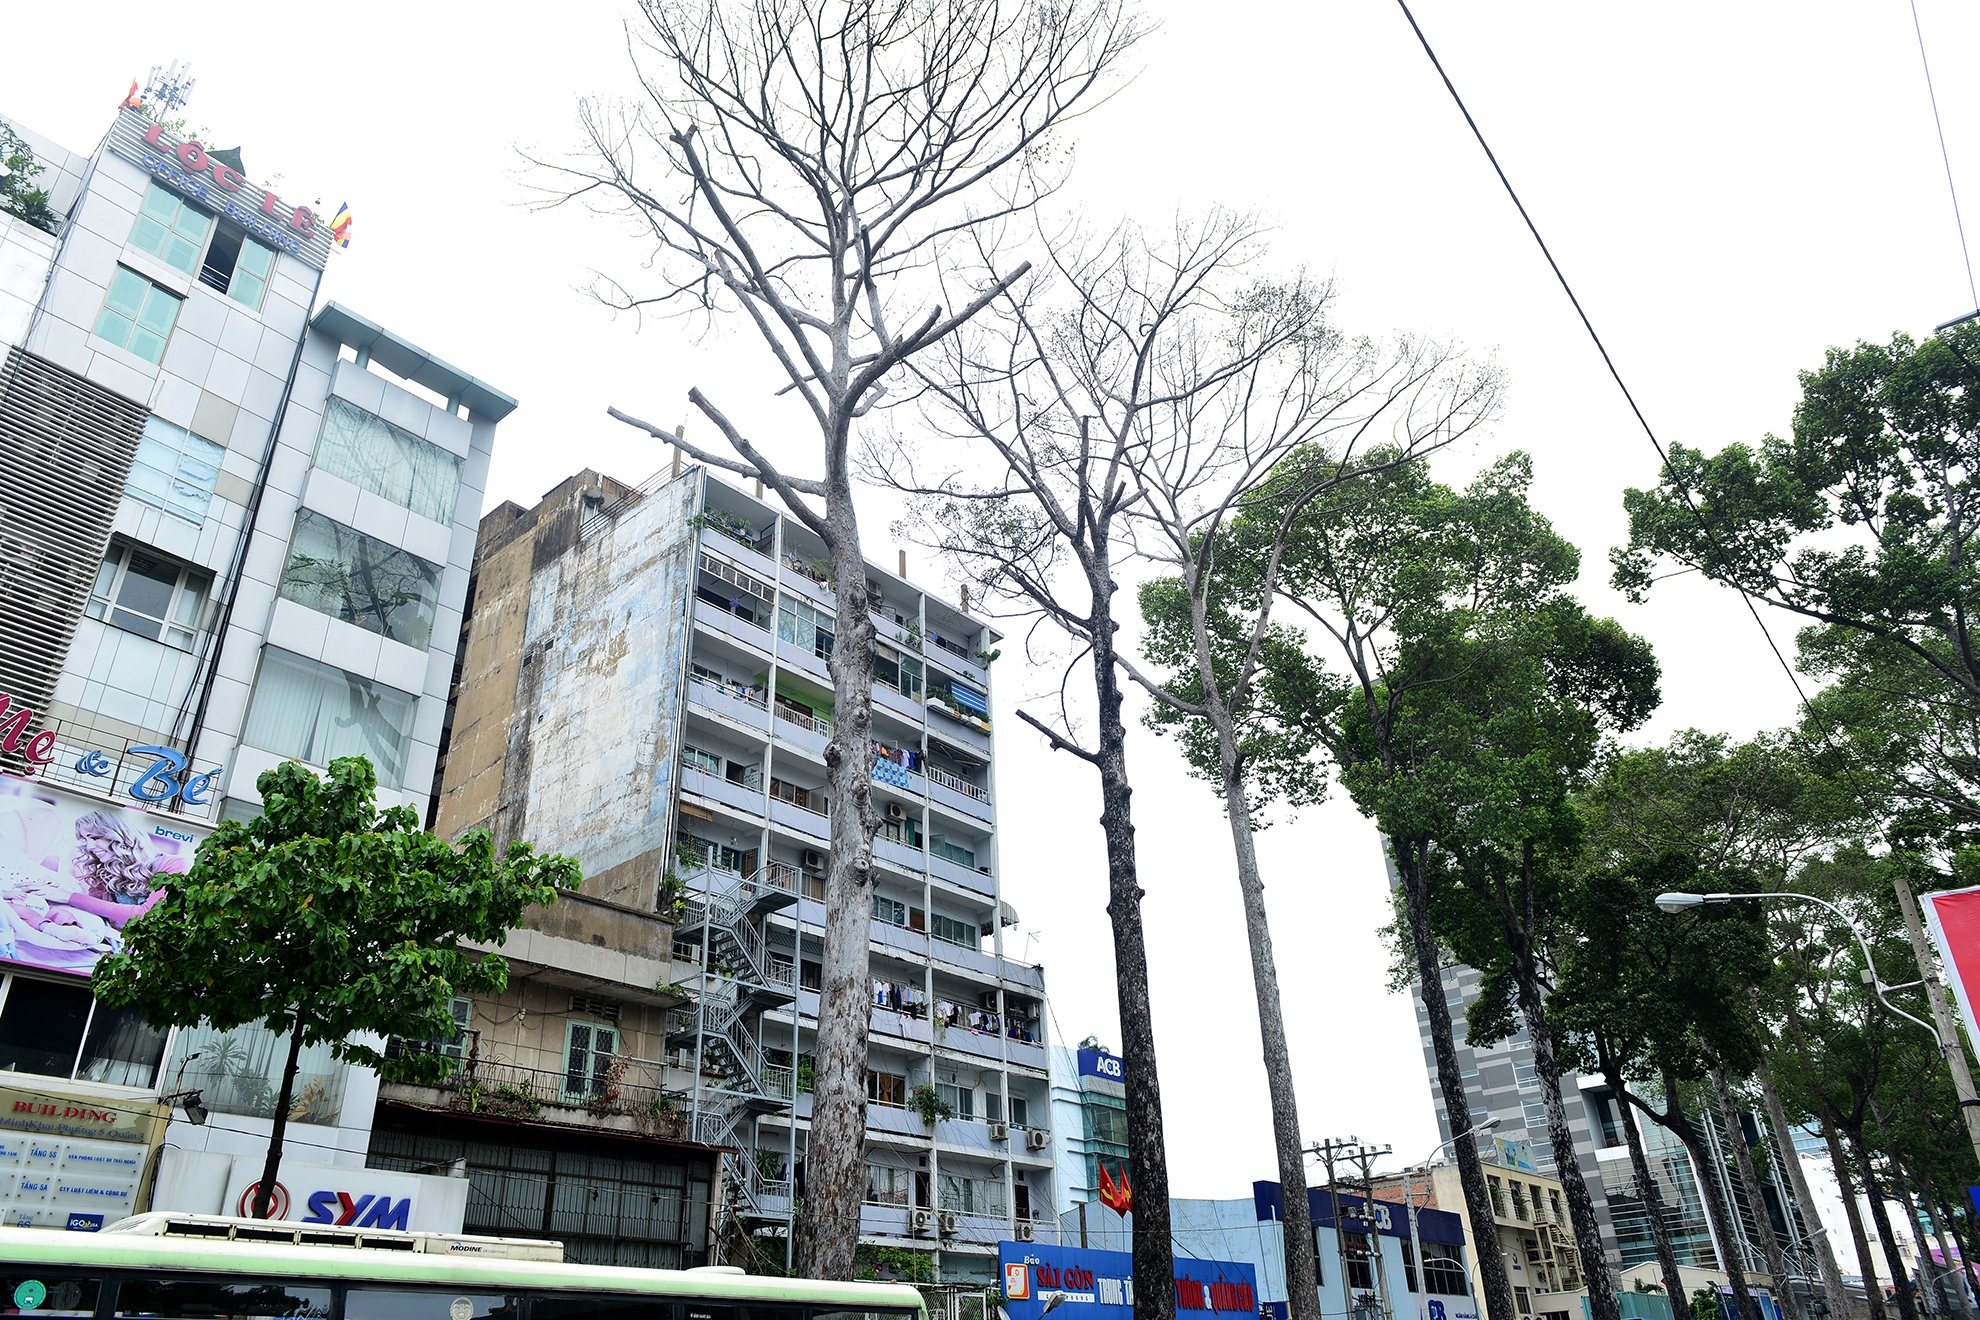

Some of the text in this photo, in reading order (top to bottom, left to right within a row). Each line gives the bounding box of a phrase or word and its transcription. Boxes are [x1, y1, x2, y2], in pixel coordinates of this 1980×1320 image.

[141, 124, 316, 240] LỘC LÊ
[142, 153, 302, 255] OFFICE BUILDING
[75, 749, 112, 778] &
[125, 744, 225, 806] Bé
[155, 824, 195, 844] brevi
[1096, 1055, 1122, 1077] ACB
[13, 1100, 118, 1124] BUILDING
[39, 1183, 48, 1191] 5A
[301, 1190, 411, 1232] SYM
[450, 1245, 482, 1253] MODINE
[1023, 1254, 1041, 1265] Báo
[1036, 1262, 1095, 1290] SÀI GÒN
